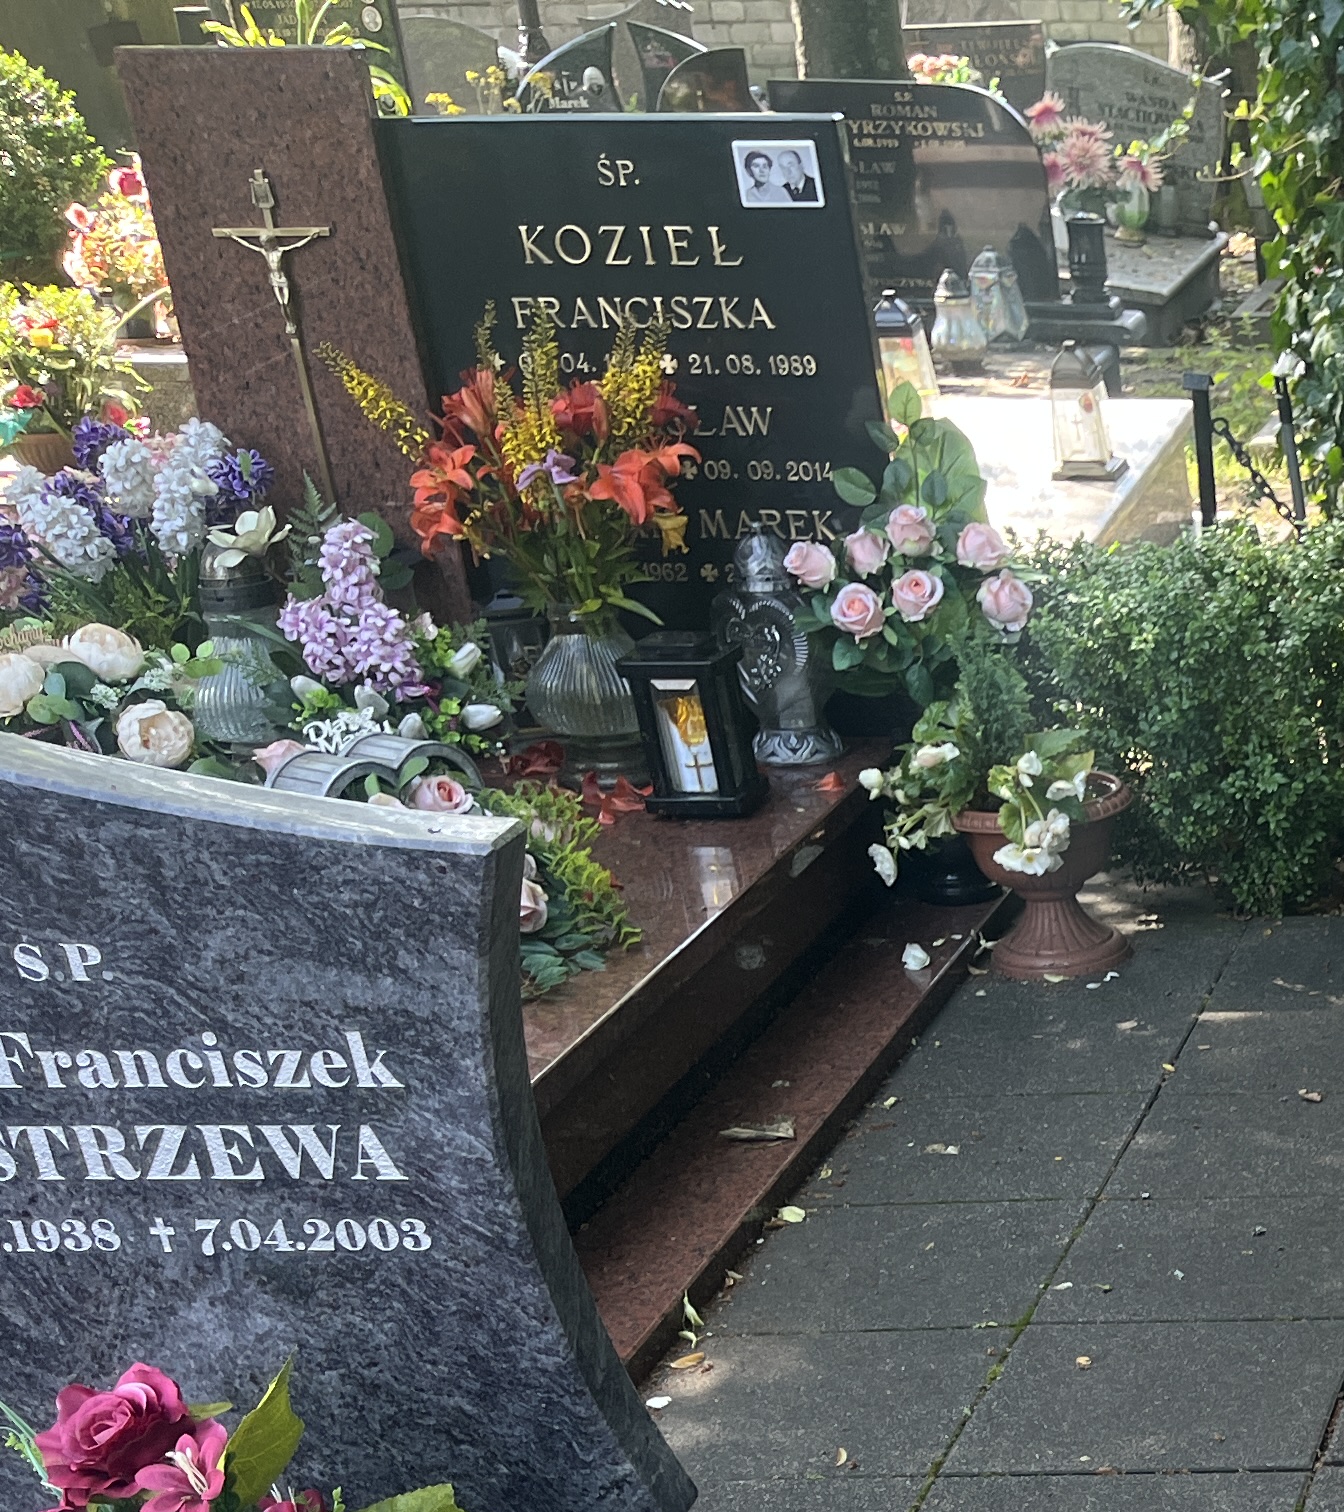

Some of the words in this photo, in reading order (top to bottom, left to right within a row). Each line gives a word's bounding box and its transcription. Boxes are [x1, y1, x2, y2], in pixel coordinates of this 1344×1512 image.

[870, 103, 938, 118] ROMAN
[848, 119, 985, 138] YRZYKOWSKI
[517, 224, 744, 266] KOZIEŁ
[511, 297, 776, 330] FRANCISZKA
[699, 509, 836, 541] MAREK
[0, 1031, 405, 1089] Franciszek
[194, 1218, 432, 1257] 7.04.2003
